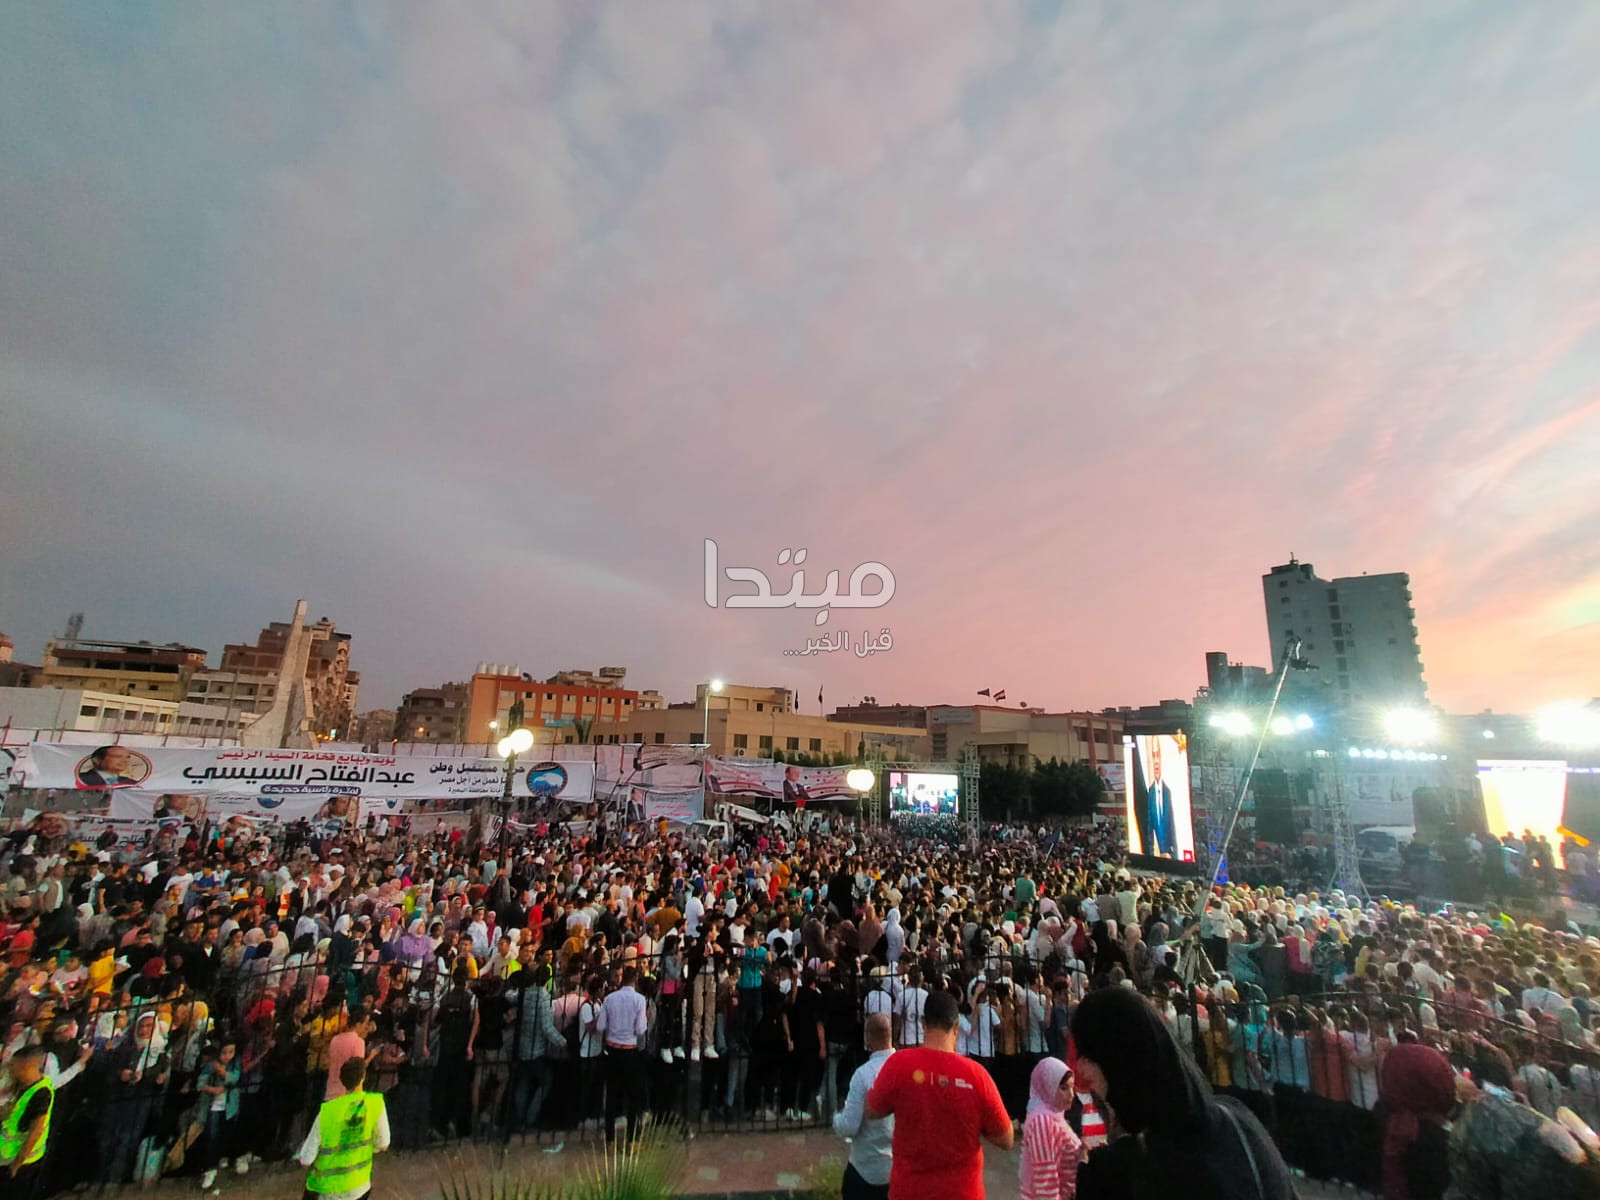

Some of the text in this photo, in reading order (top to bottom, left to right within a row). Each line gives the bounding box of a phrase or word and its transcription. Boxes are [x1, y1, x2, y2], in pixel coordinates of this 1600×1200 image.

[216, 750, 262, 760] الرئيس
[265, 751, 299, 761] السيد
[302, 751, 335, 761] فخامة
[430, 761, 453, 774] وطن
[182, 764, 304, 784] السيسي
[263, 785, 299, 793] جديدة
